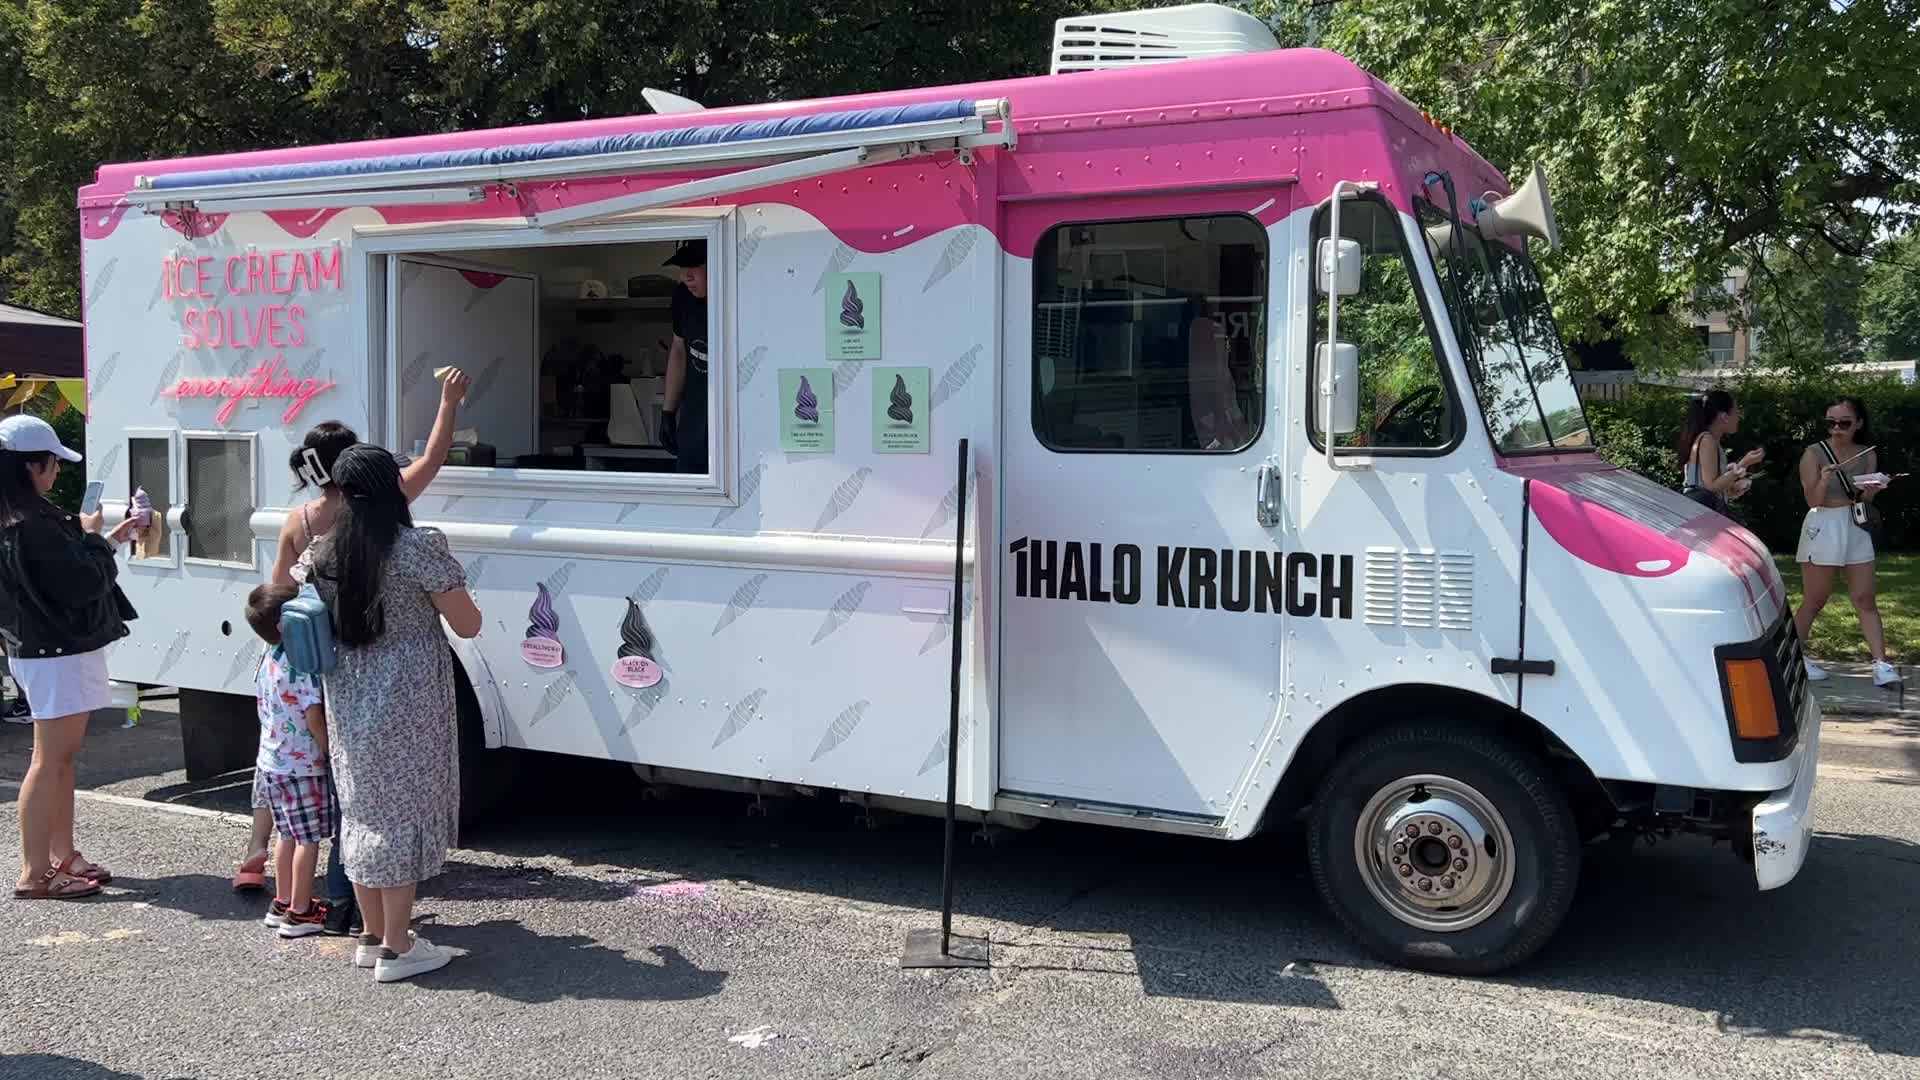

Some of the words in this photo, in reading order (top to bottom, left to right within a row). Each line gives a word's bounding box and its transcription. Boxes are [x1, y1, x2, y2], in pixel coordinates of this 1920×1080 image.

[161, 255, 215, 300] ICE
[224, 245, 343, 296] CREAM
[183, 303, 306, 350] SOLVES
[160, 353, 336, 425] everything
[1156, 545, 1354, 620] KRUNCH
